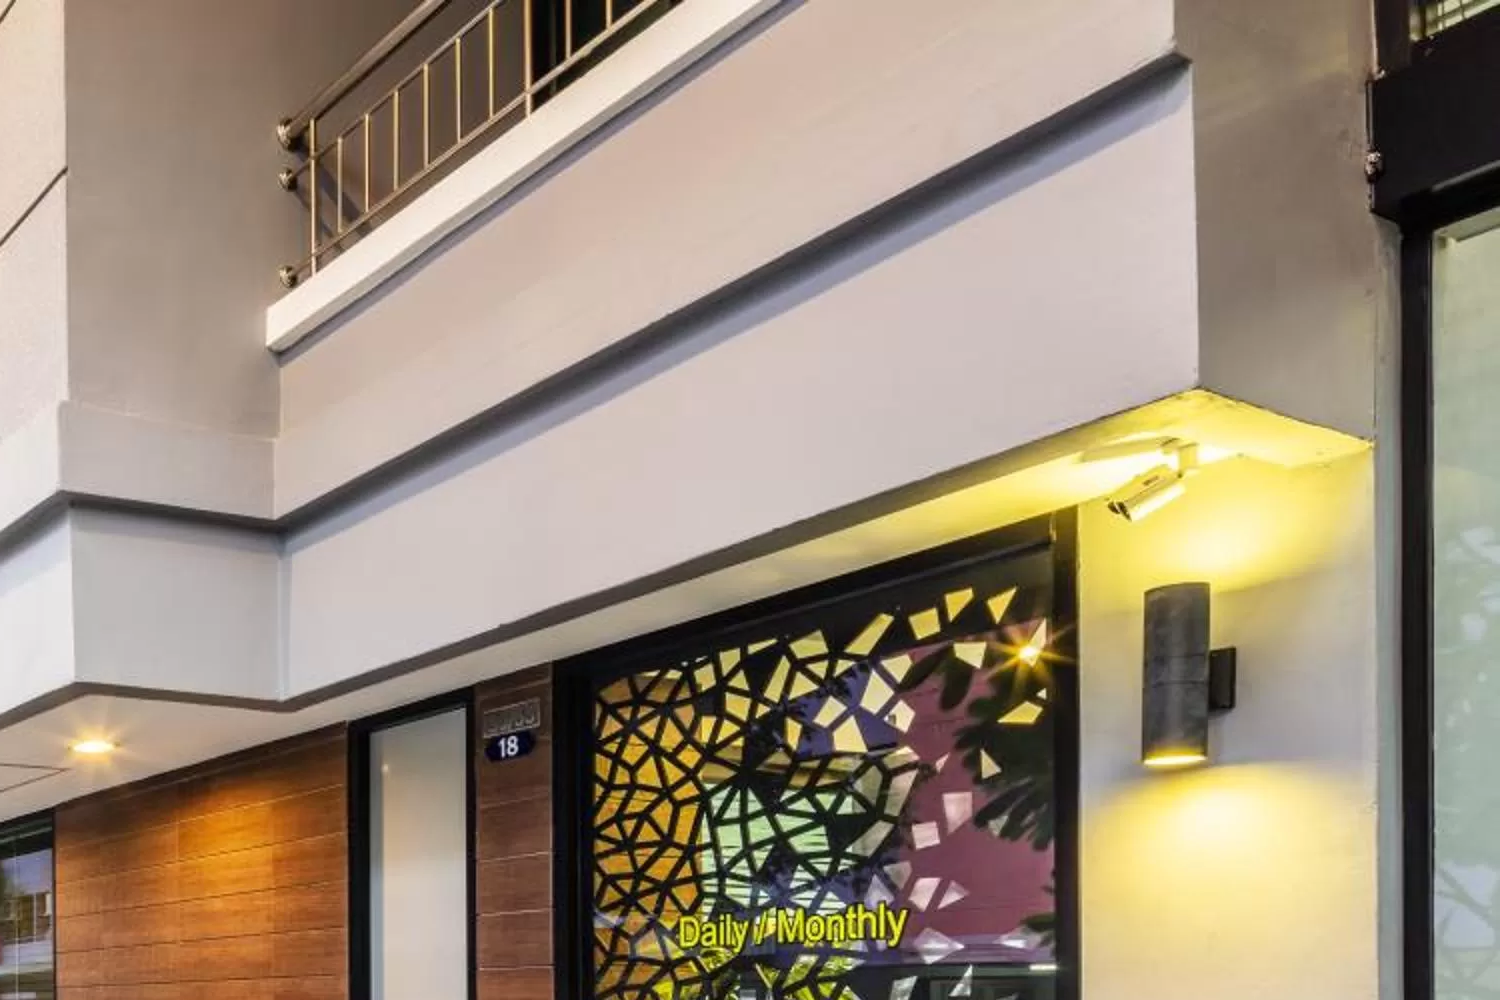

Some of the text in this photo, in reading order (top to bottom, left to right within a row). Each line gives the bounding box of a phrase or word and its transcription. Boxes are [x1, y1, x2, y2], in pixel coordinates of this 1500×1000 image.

[498, 735, 519, 758] 18
[679, 902, 909, 953] Daily / Monthly
